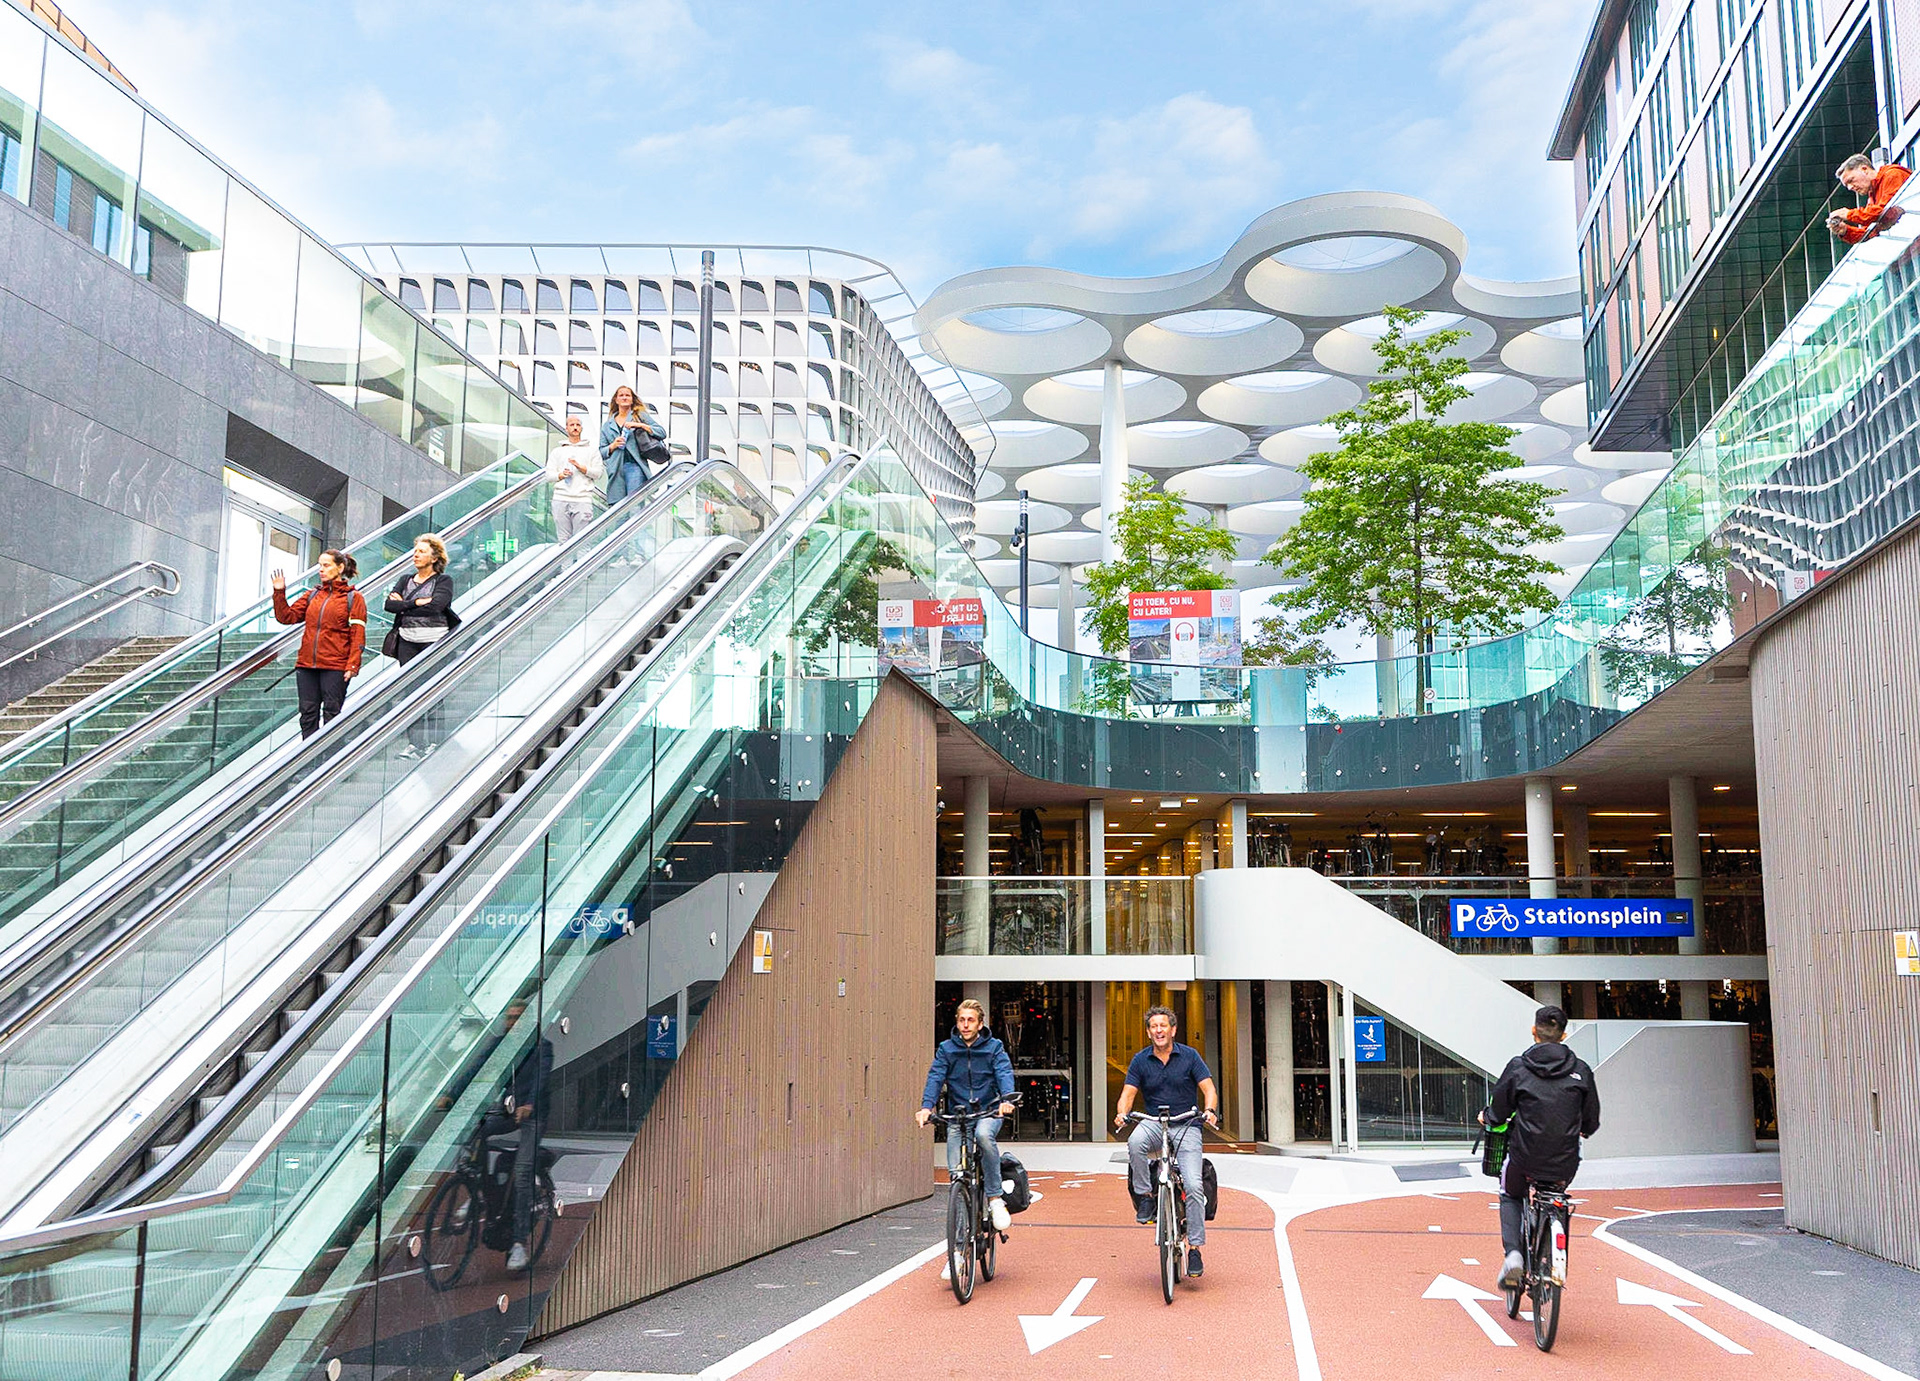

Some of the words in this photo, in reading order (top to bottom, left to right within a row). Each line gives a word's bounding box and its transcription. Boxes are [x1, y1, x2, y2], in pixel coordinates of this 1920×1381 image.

[1133, 598, 1144, 606] CU
[1145, 597, 1168, 606] TOEN,
[1169, 597, 1180, 605] CU
[1181, 597, 1196, 605] NU,
[1133, 608, 1144, 616] CU
[1456, 904, 1476, 932] P
[1524, 907, 1662, 929] Stationsplein
